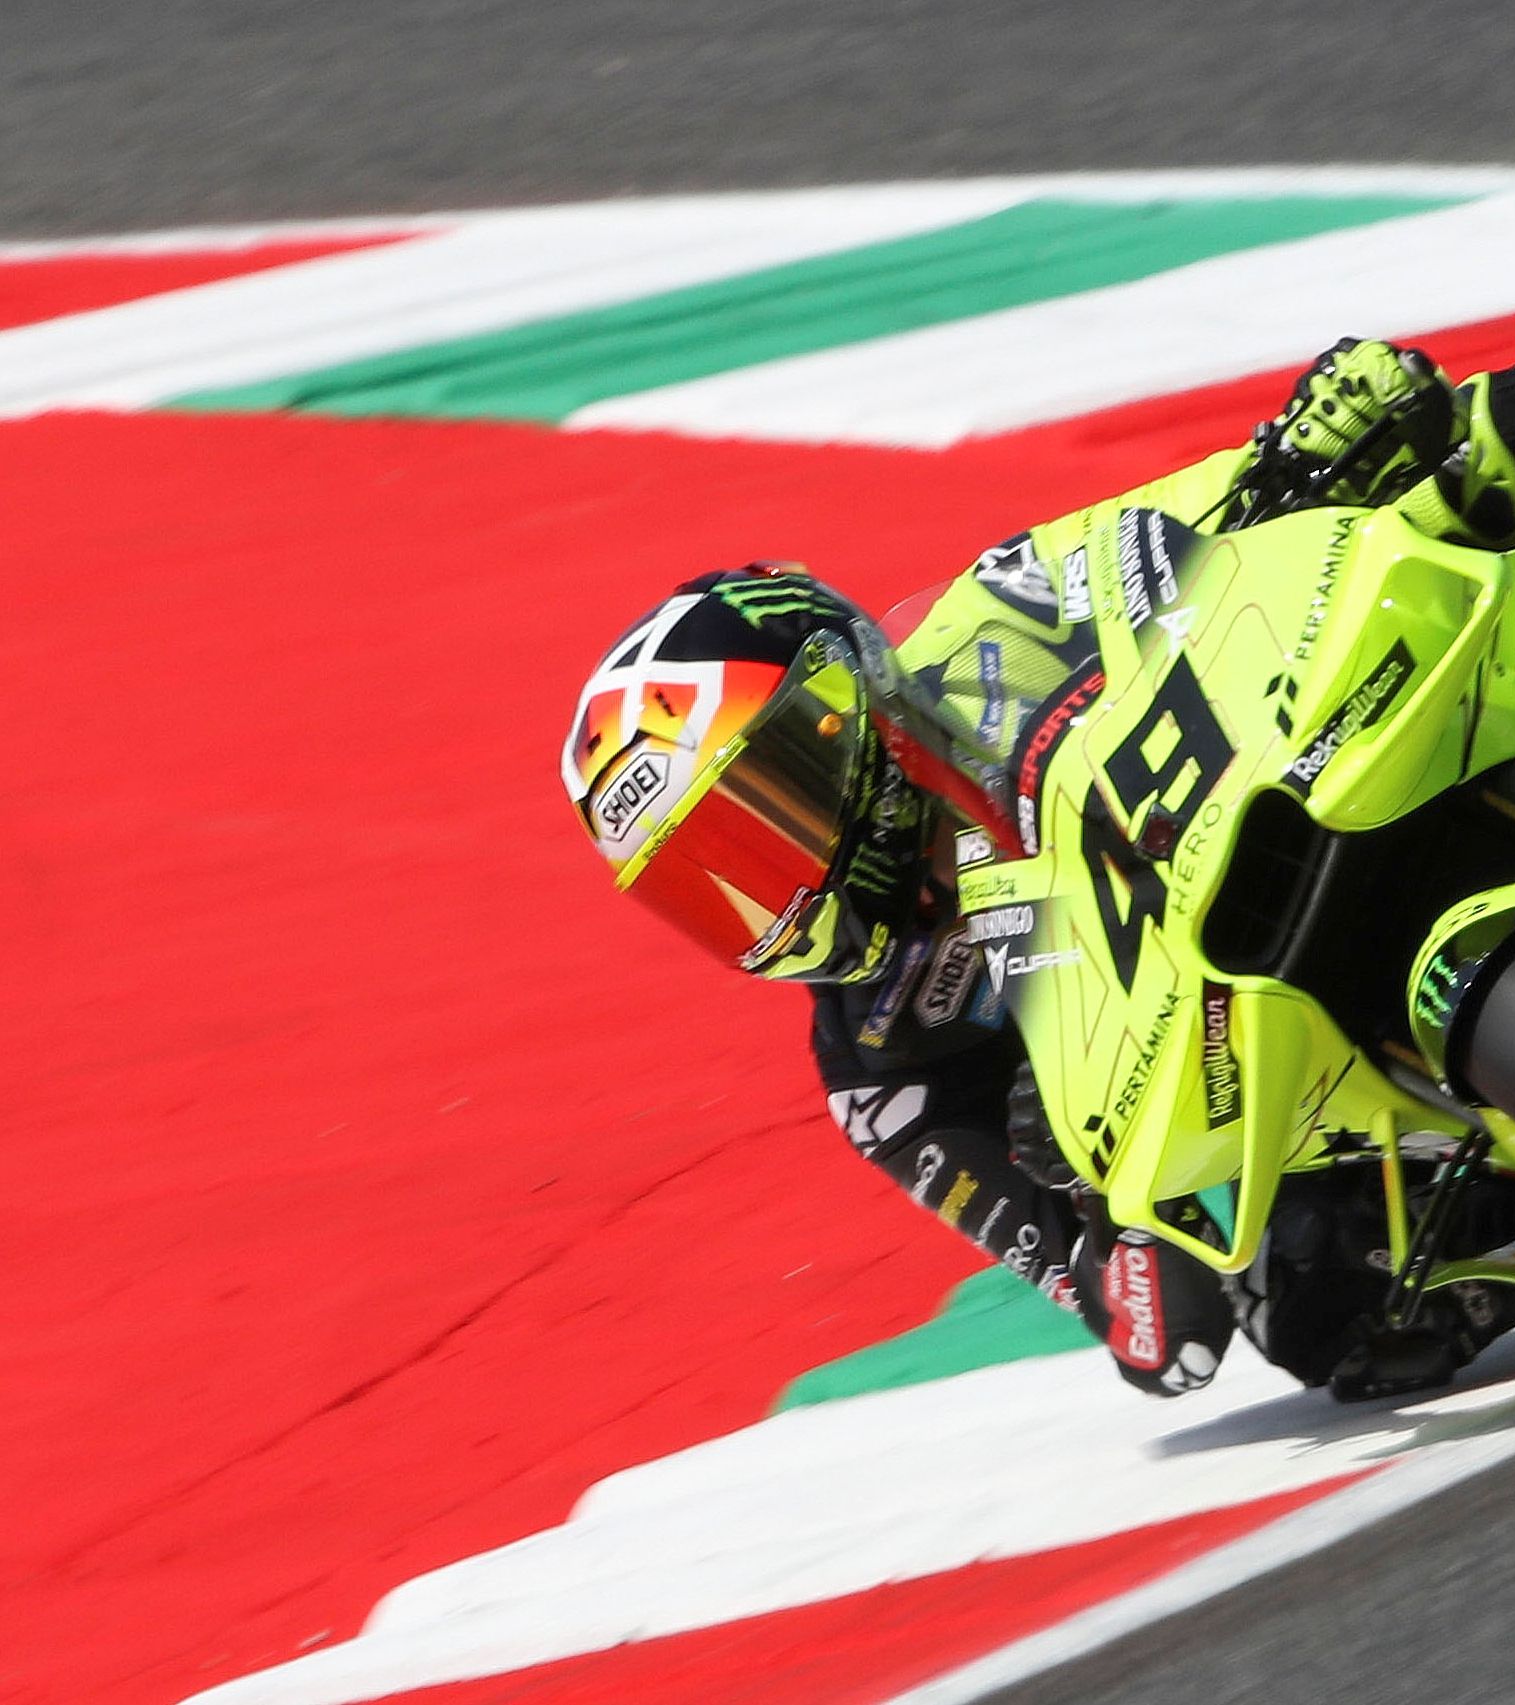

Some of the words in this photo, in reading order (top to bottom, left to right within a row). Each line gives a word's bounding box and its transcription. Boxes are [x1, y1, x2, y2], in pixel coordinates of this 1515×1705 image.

[1148, 510, 1179, 605] CUPRA
[1295, 515, 1360, 661] PERTAMINA
[602, 760, 660, 832] SHOEI
[1080, 650, 1238, 998] 49
[1170, 803, 1223, 915] HERO
[1114, 990, 1181, 1122] PERTAMINA
[1127, 1245, 1159, 1362] Enduro
